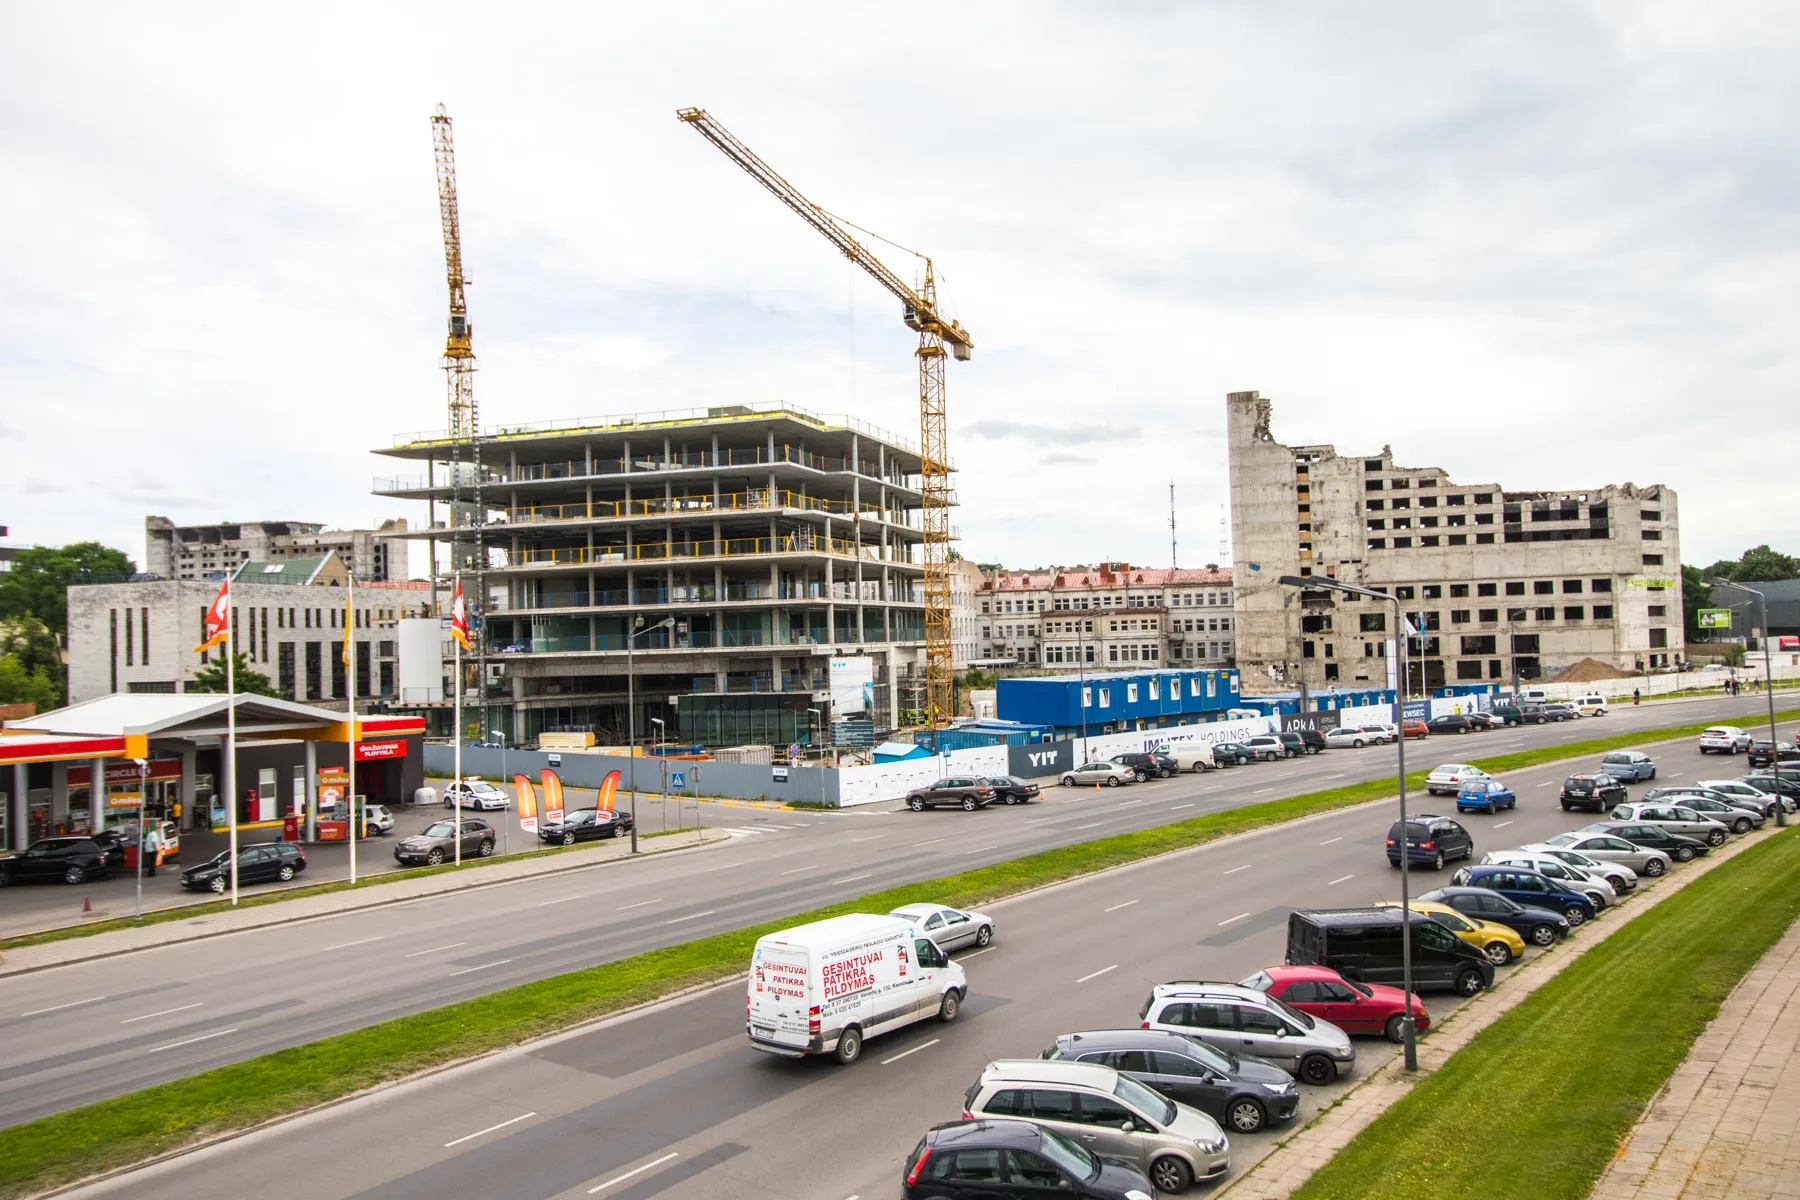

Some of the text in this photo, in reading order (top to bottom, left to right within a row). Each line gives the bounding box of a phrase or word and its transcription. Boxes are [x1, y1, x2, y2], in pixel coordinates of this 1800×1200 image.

[1403, 709, 1425, 718] EWSEC
[1028, 750, 1058, 767] YIT
[763, 962, 807, 975] GESINTUVAI
[822, 951, 883, 977] GESINTUVAI
[773, 975, 804, 986] PATIKRA
[823, 966, 866, 987] PATIKRA
[767, 986, 804, 998] PILDYMAS
[824, 974, 875, 998] PILDYMAS
